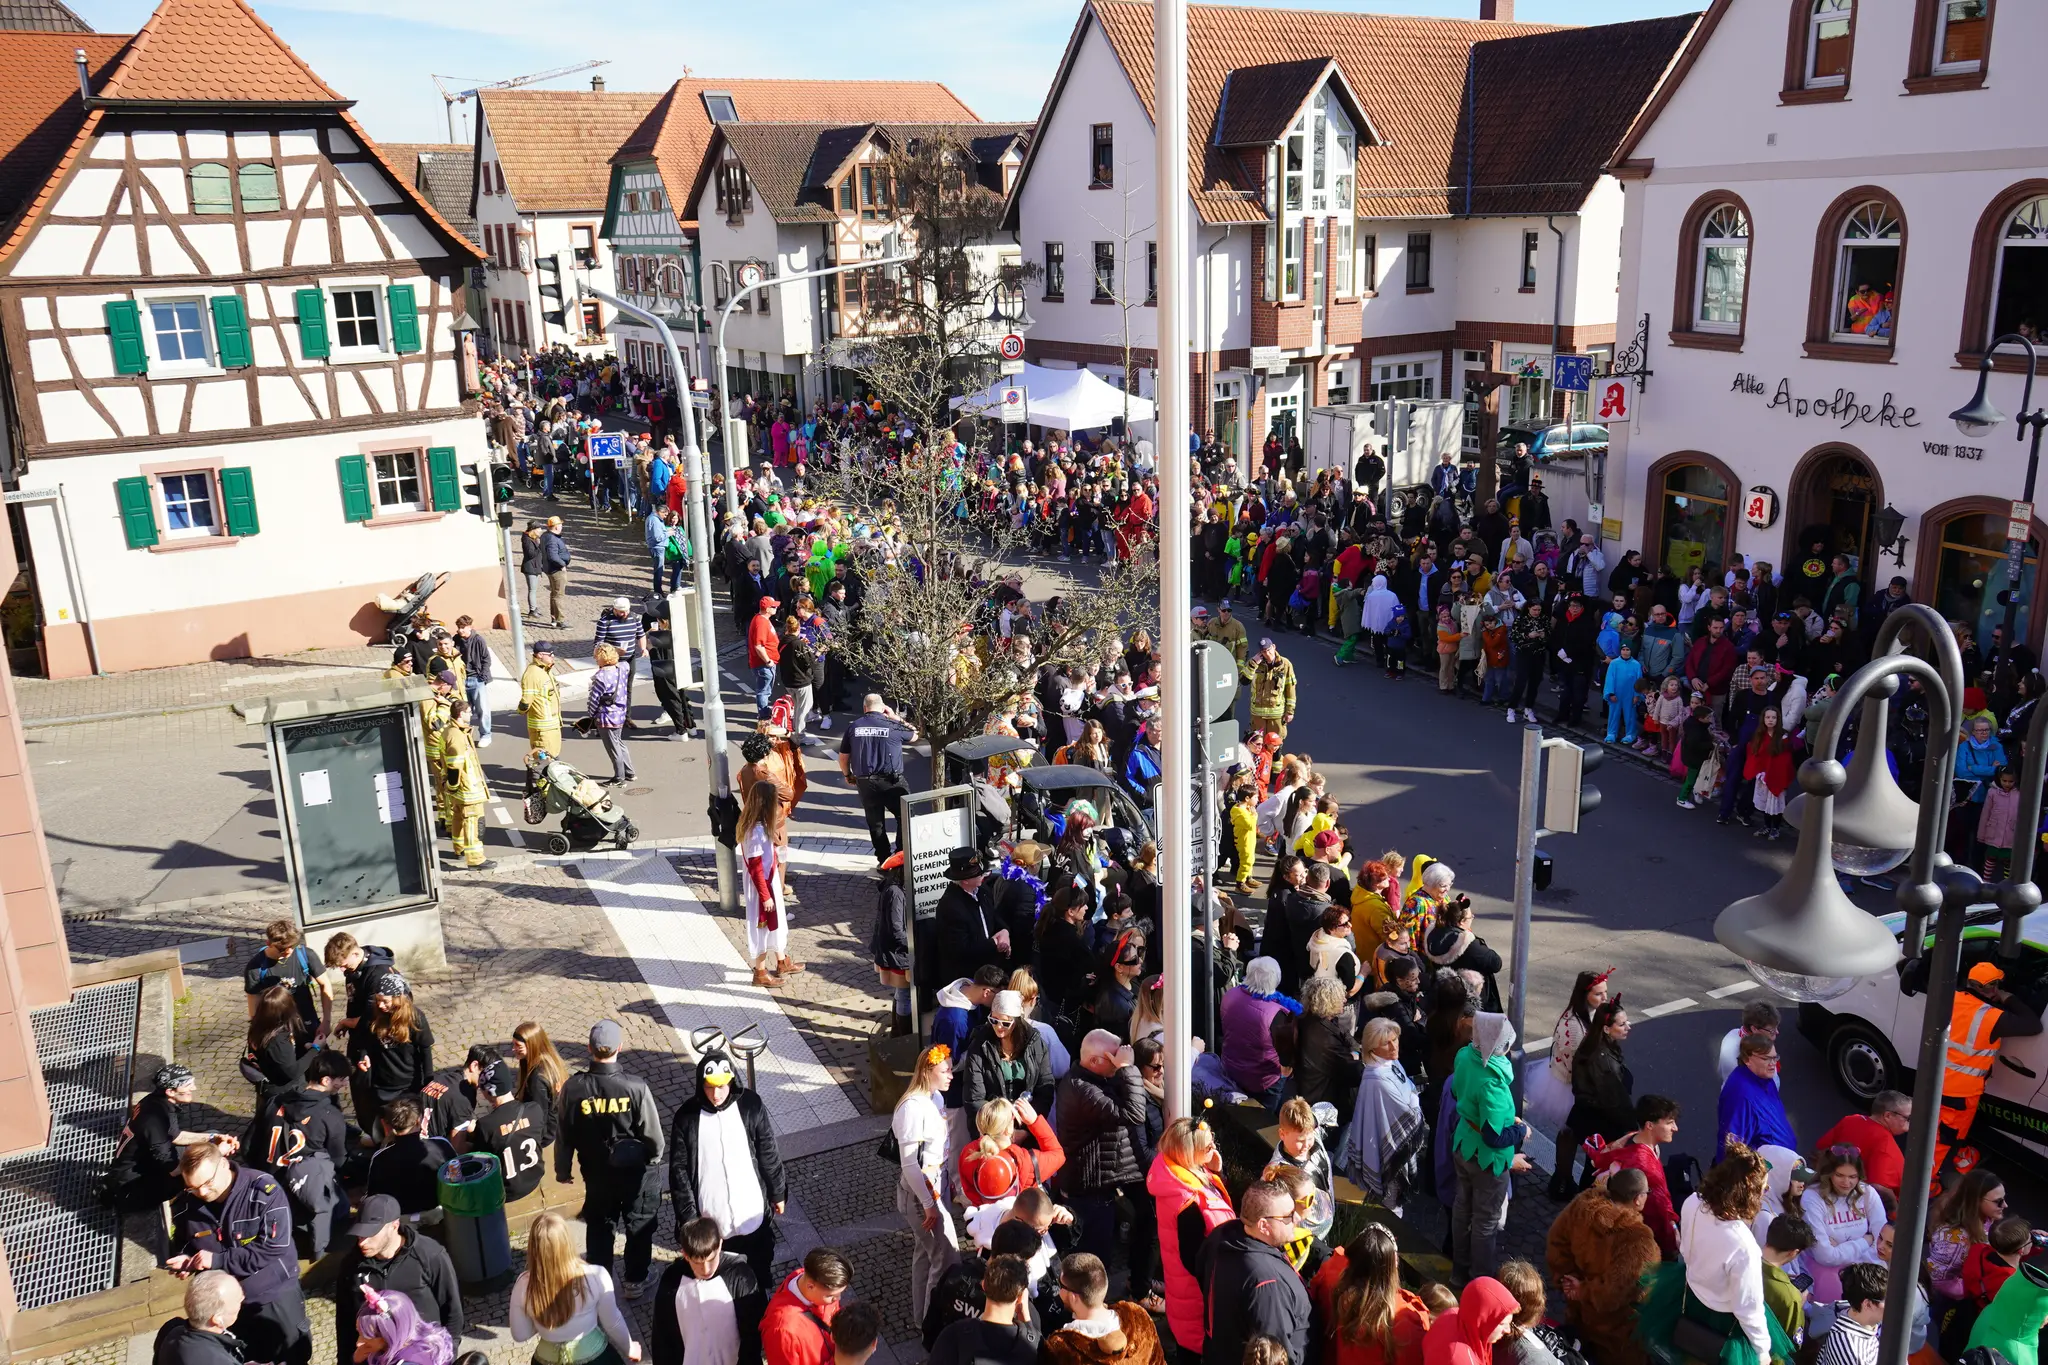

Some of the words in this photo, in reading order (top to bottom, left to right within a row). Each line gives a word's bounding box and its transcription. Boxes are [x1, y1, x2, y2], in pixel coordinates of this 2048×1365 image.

[1005, 341, 1019, 353] 30
[1730, 372, 1765, 395] Alte
[1766, 377, 1921, 430] Apotheke
[1923, 441, 1949, 457] von
[1953, 444, 1984, 461] 1837
[292, 717, 395, 738] BEKANNTMACHUNGEN
[855, 727, 888, 737] SECURITY
[912, 859, 950, 873] GEMEIND
[914, 881, 949, 895] HERXHEI
[1978, 1101, 2048, 1132] NTECHNIK
[266, 1125, 303, 1167] 12
[503, 1138, 539, 1180] 13
[953, 1298, 981, 1320] SW
